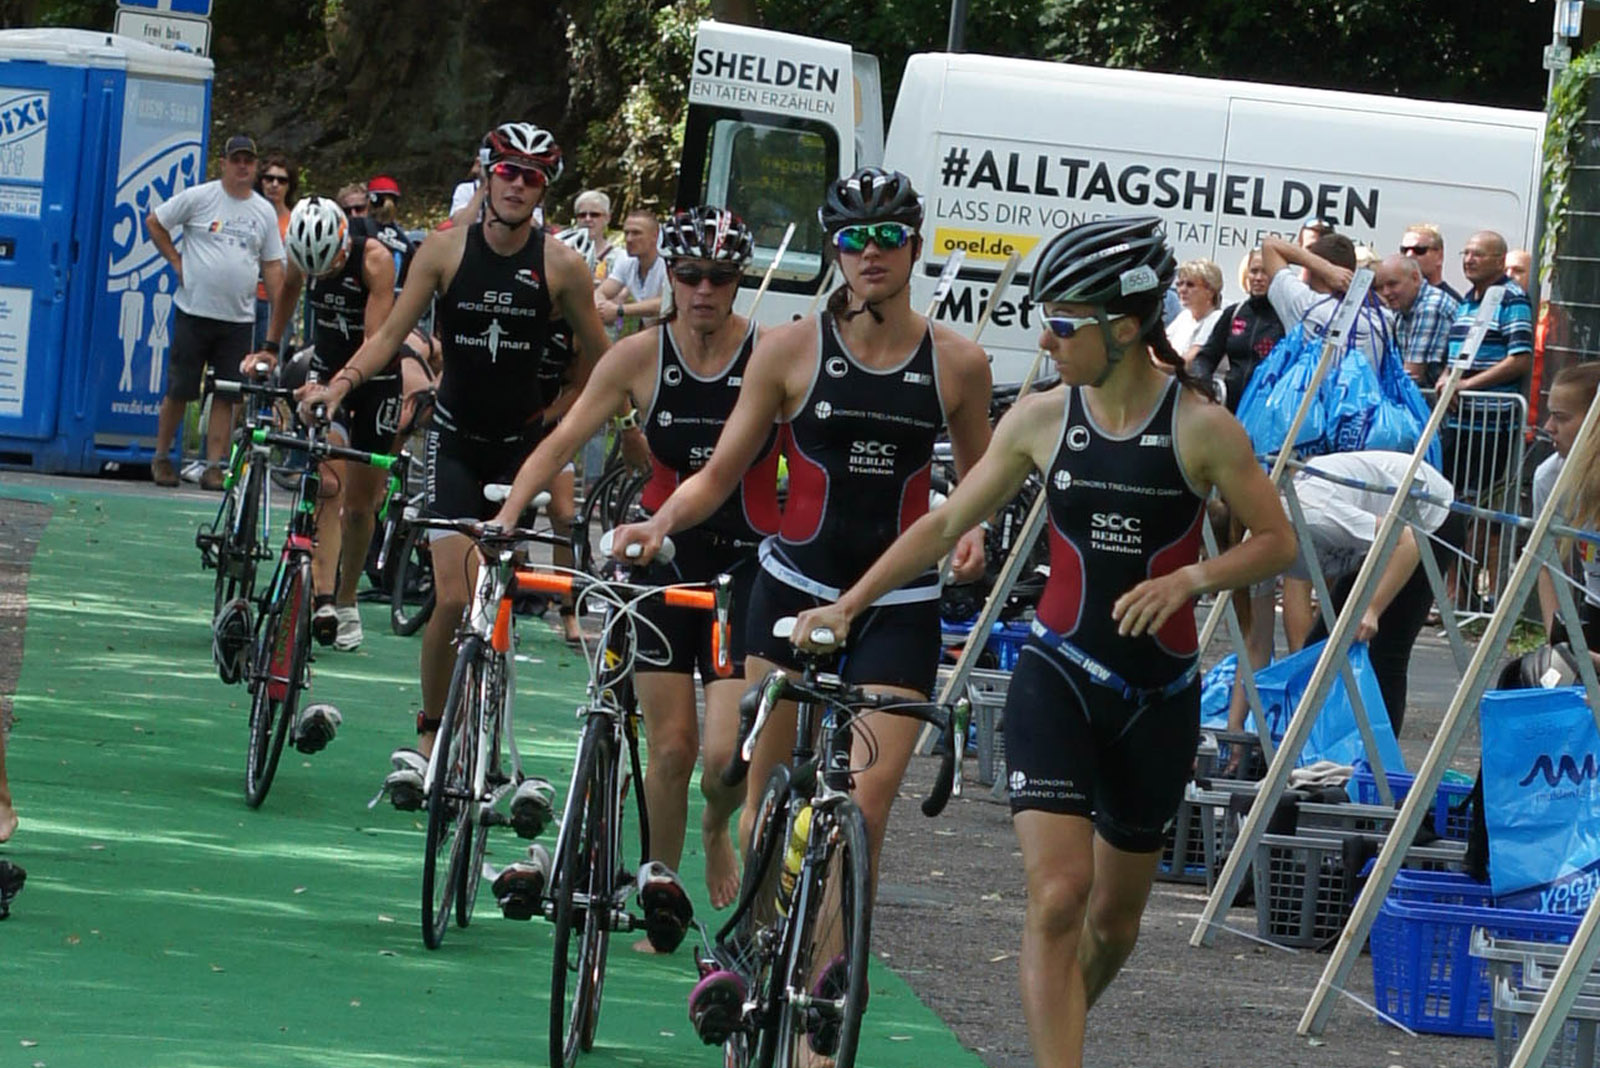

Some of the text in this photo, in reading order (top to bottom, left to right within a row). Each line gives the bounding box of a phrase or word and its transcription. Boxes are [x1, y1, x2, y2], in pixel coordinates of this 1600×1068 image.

[143, 24, 181, 39] frei bis
[695, 49, 840, 94] SHELDEN
[692, 82, 836, 115] EN TATEN ERZÄHLEN
[941, 146, 1380, 229] #ALLTAGSHELDEN
[936, 198, 989, 222] LASS
[996, 203, 1032, 227] DIR
[1039, 207, 1085, 230] VON
[483, 290, 513, 305] SG
[500, 340, 531, 350] mara
[689, 447, 715, 459] SC
[850, 440, 899, 456] SCC
[849, 455, 895, 467] BERLIN
[848, 465, 895, 475] Triathlon
[1091, 513, 1141, 532] SCC
[1091, 530, 1142, 544] BERLIN
[1091, 541, 1142, 554] Triathlon
